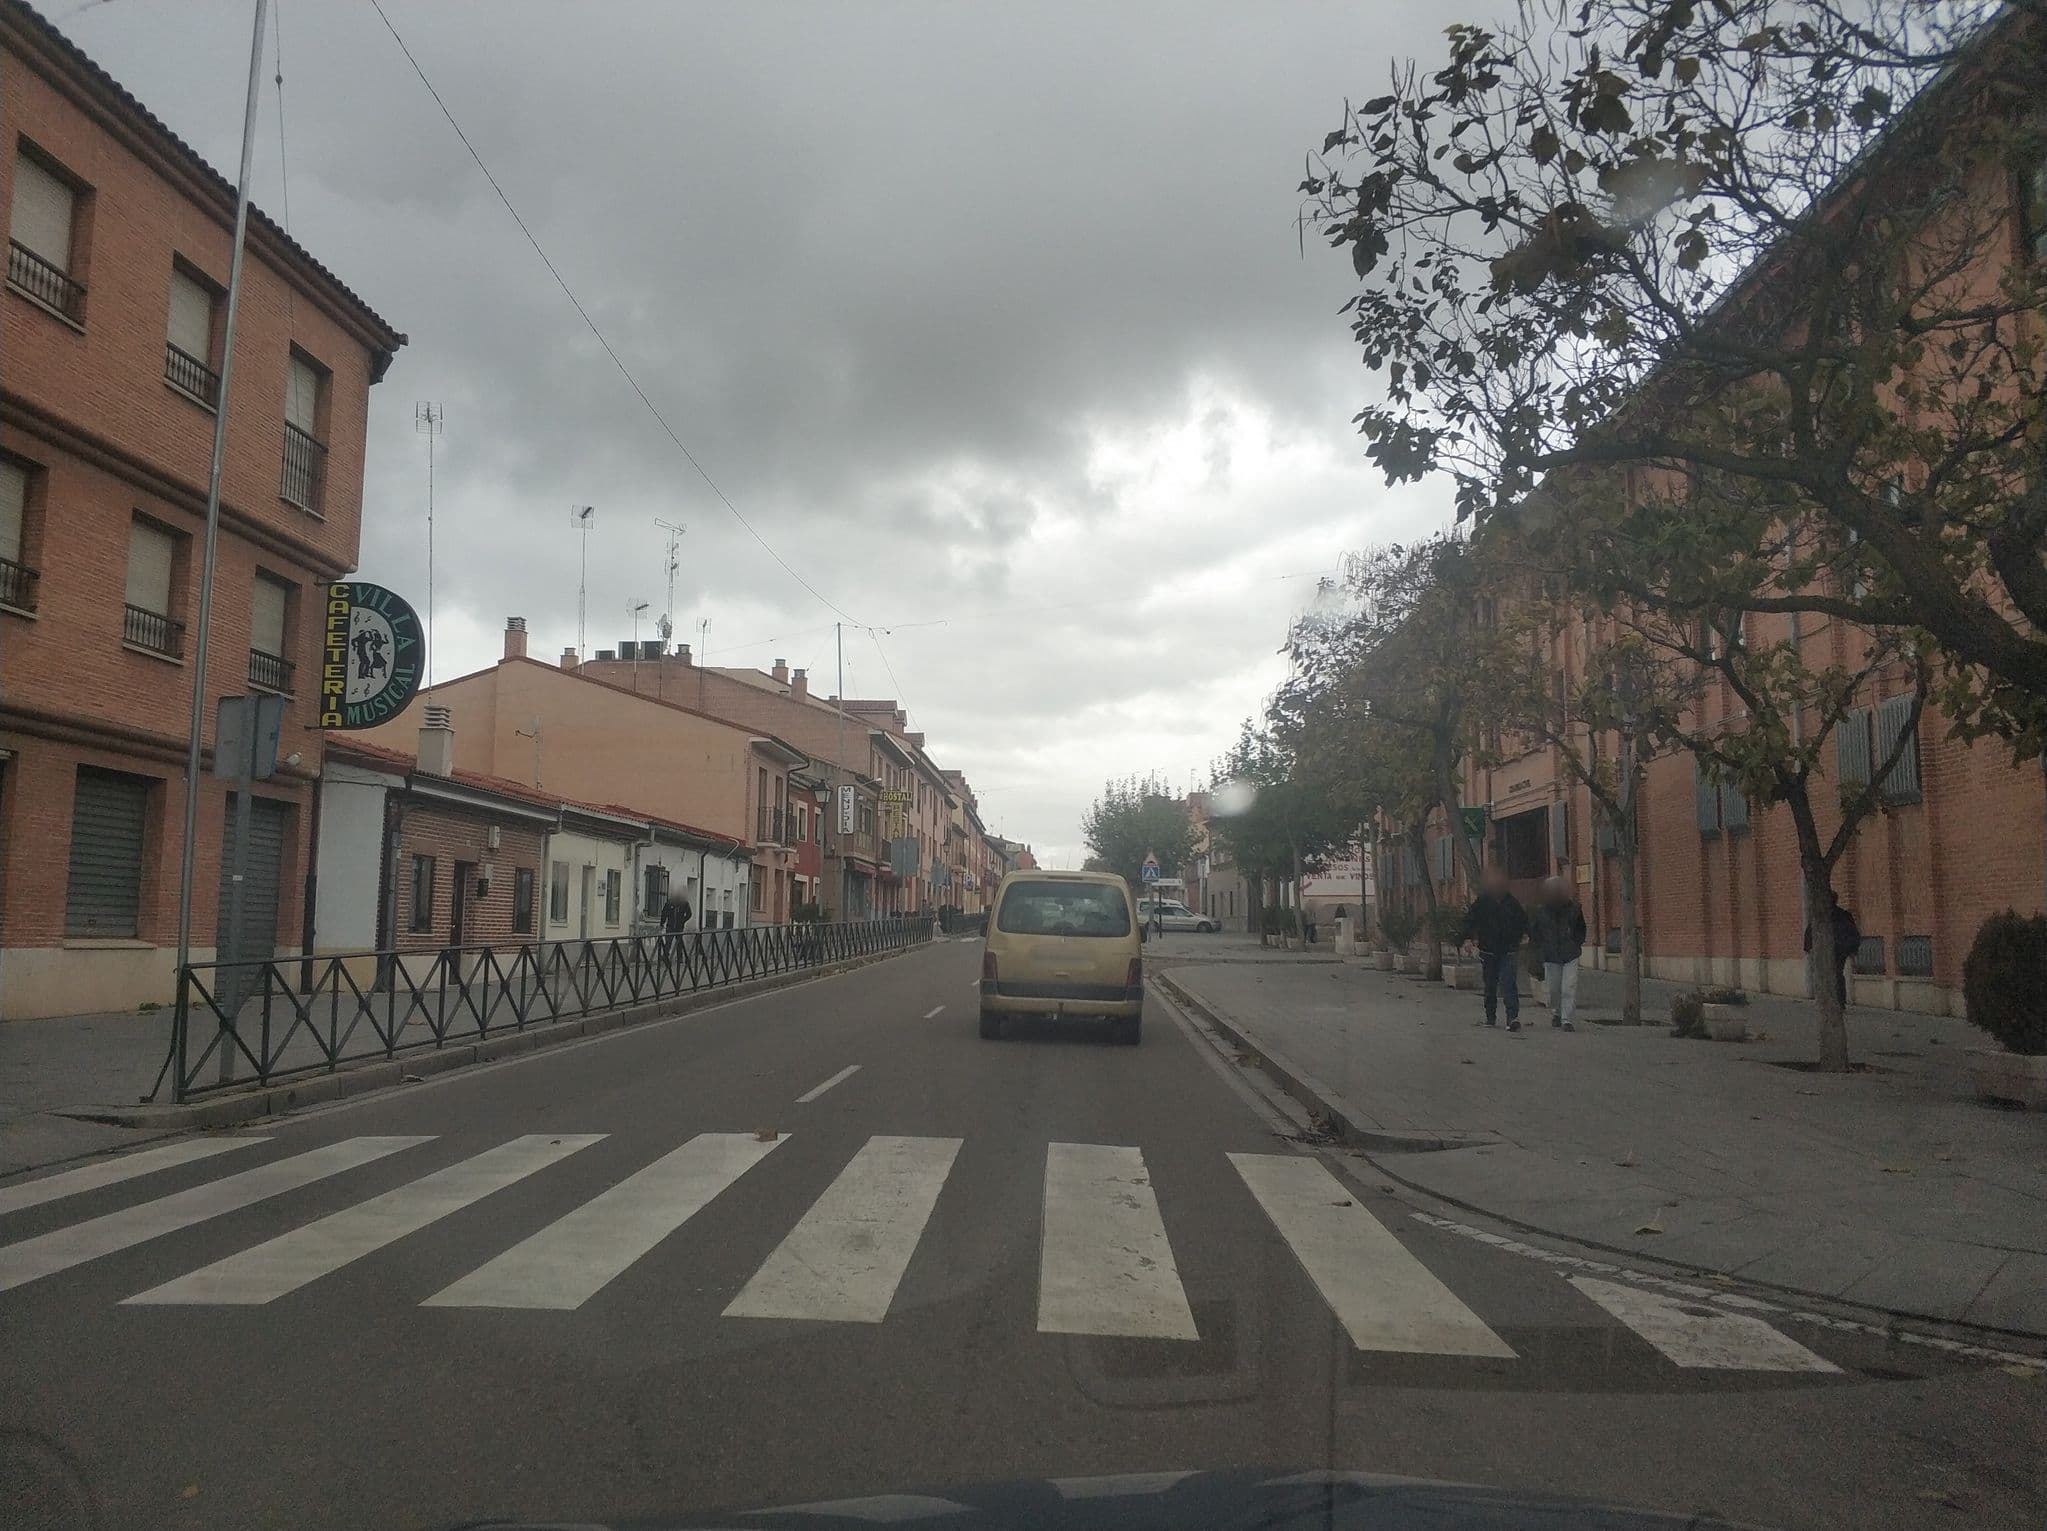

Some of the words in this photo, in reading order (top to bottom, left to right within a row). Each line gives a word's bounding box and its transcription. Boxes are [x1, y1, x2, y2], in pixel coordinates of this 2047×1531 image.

[355, 584, 417, 651] VILLA
[321, 584, 350, 727] CAFETERIA
[346, 663, 415, 726] MUSICAL
[883, 791, 913, 801] HOSTAL
